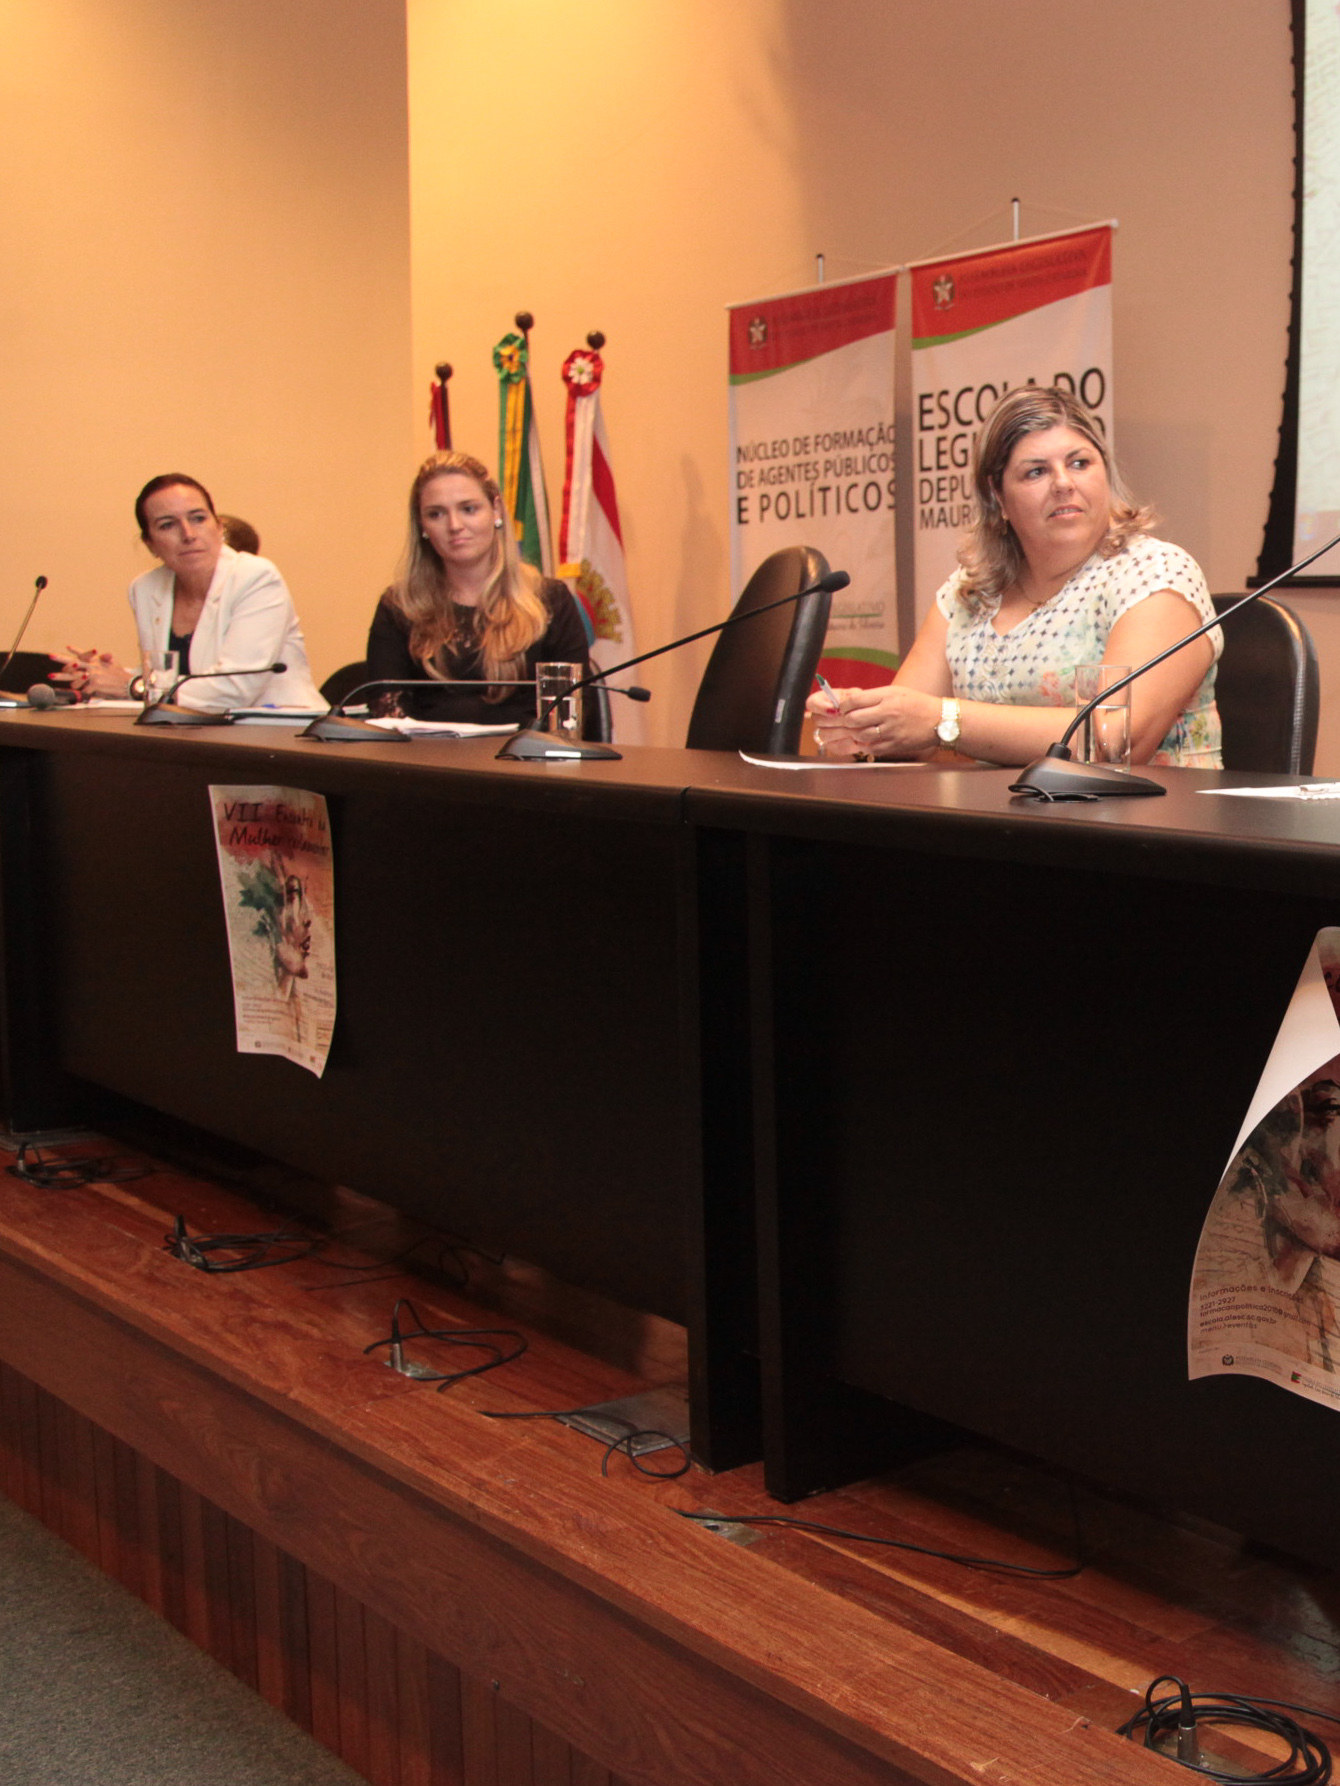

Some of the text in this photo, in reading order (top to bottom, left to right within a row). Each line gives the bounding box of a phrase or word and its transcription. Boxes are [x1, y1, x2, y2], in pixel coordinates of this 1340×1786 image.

[919, 378, 1036, 431] ESCO
[737, 422, 895, 463] NÚCLEO DE FORMAÇÃO
[737, 470, 754, 489] DE
[758, 460, 820, 487] AGENTES
[737, 478, 895, 524] E POLÍTICOS
[224, 801, 263, 823] VII
